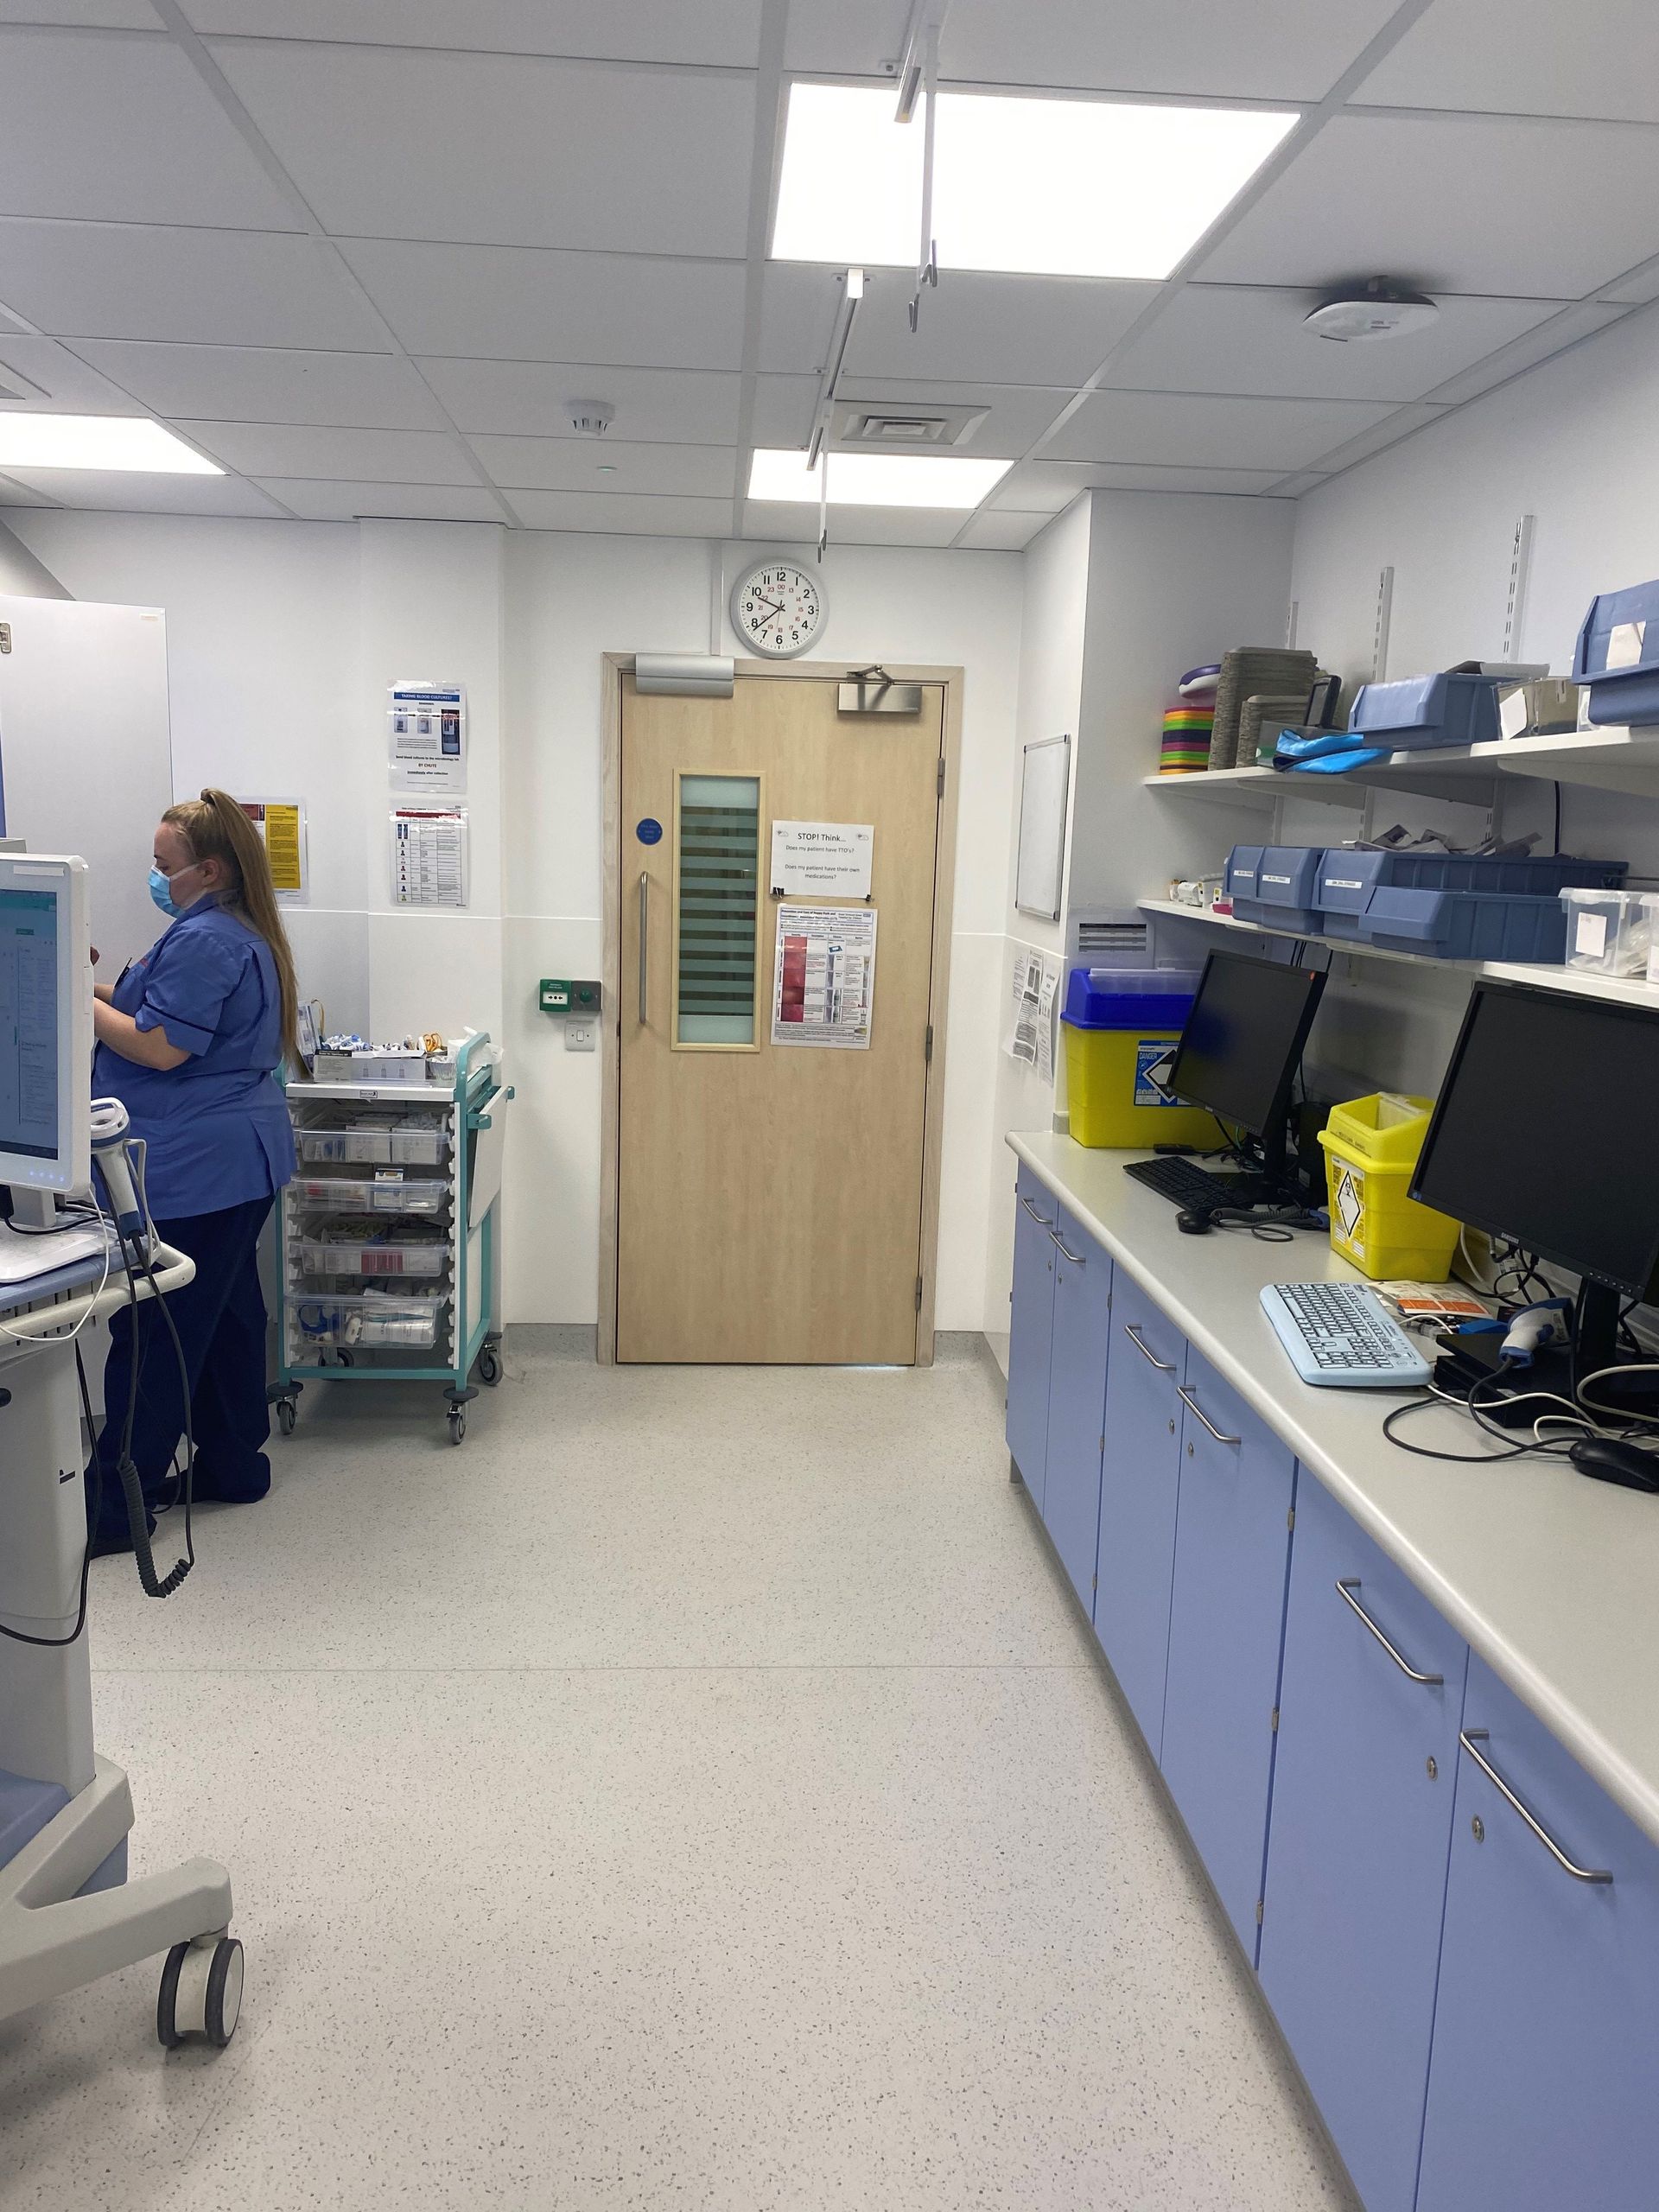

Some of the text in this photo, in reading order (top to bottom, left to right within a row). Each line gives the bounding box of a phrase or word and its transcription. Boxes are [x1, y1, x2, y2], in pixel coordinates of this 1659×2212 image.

[764, 575, 770, 585] 11
[777, 572, 786, 582] 12
[752, 587, 762, 596] 10
[803, 589, 810, 599] 2
[746, 602, 753, 612] 9
[808, 606, 815, 614] 3
[751, 618, 758, 627] 8
[802, 620, 809, 629] 4
[761, 630, 768, 639] 7
[791, 631, 798, 640] 5
[776, 635, 783, 645] 6
